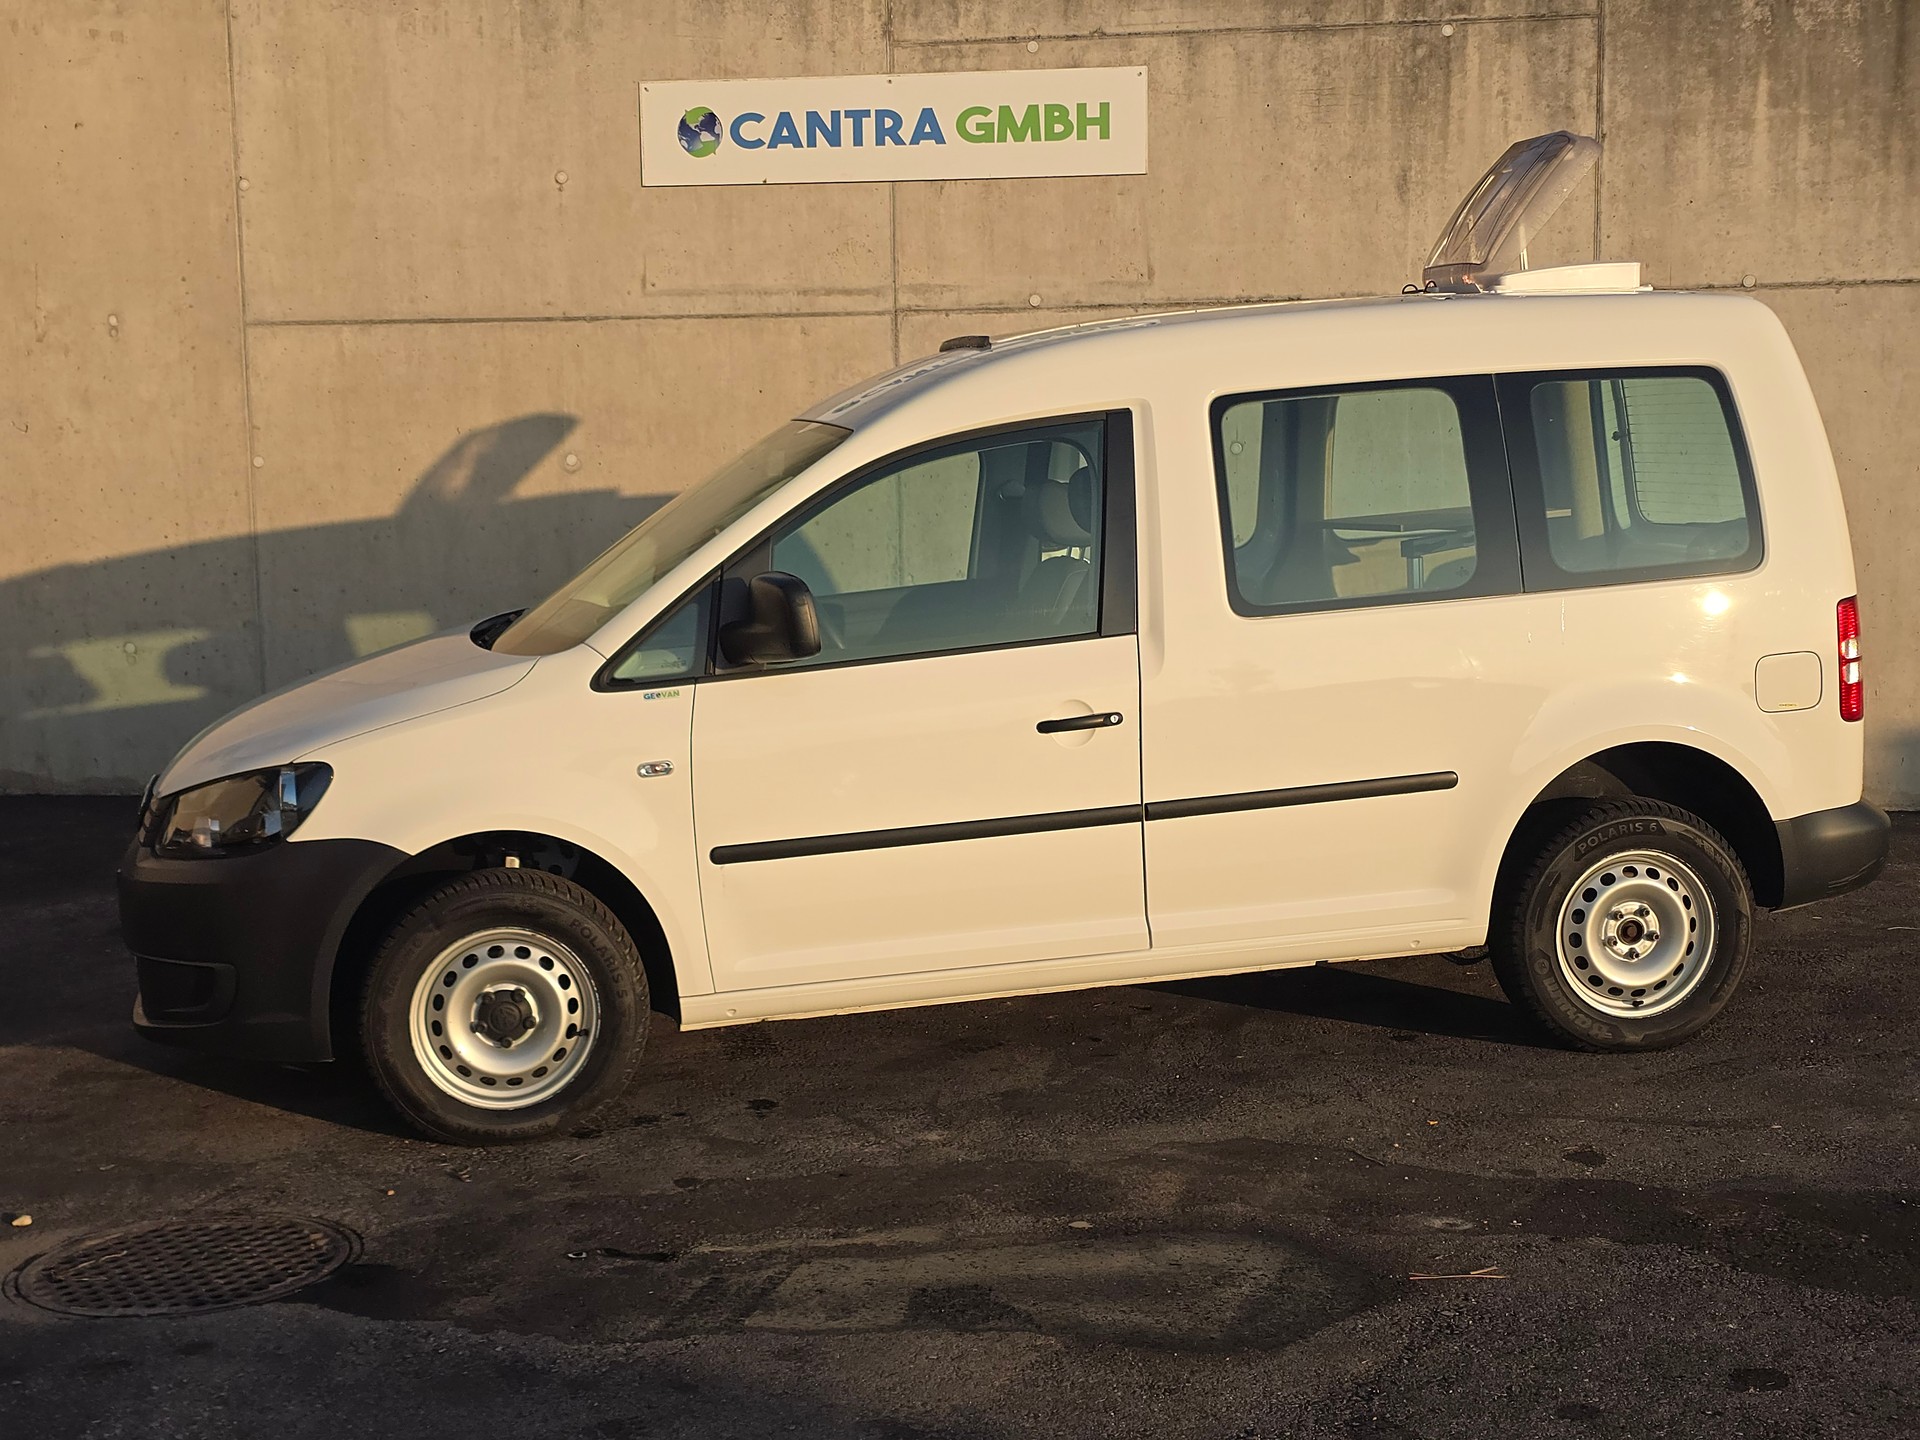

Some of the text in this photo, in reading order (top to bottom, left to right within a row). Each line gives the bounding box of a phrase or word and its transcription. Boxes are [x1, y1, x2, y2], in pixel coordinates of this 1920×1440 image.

[729, 102, 1110, 150] CANTRA GMBH
[1577, 822, 1657, 854] POLARIS 6
[568, 918, 628, 999] POLARIS 5
